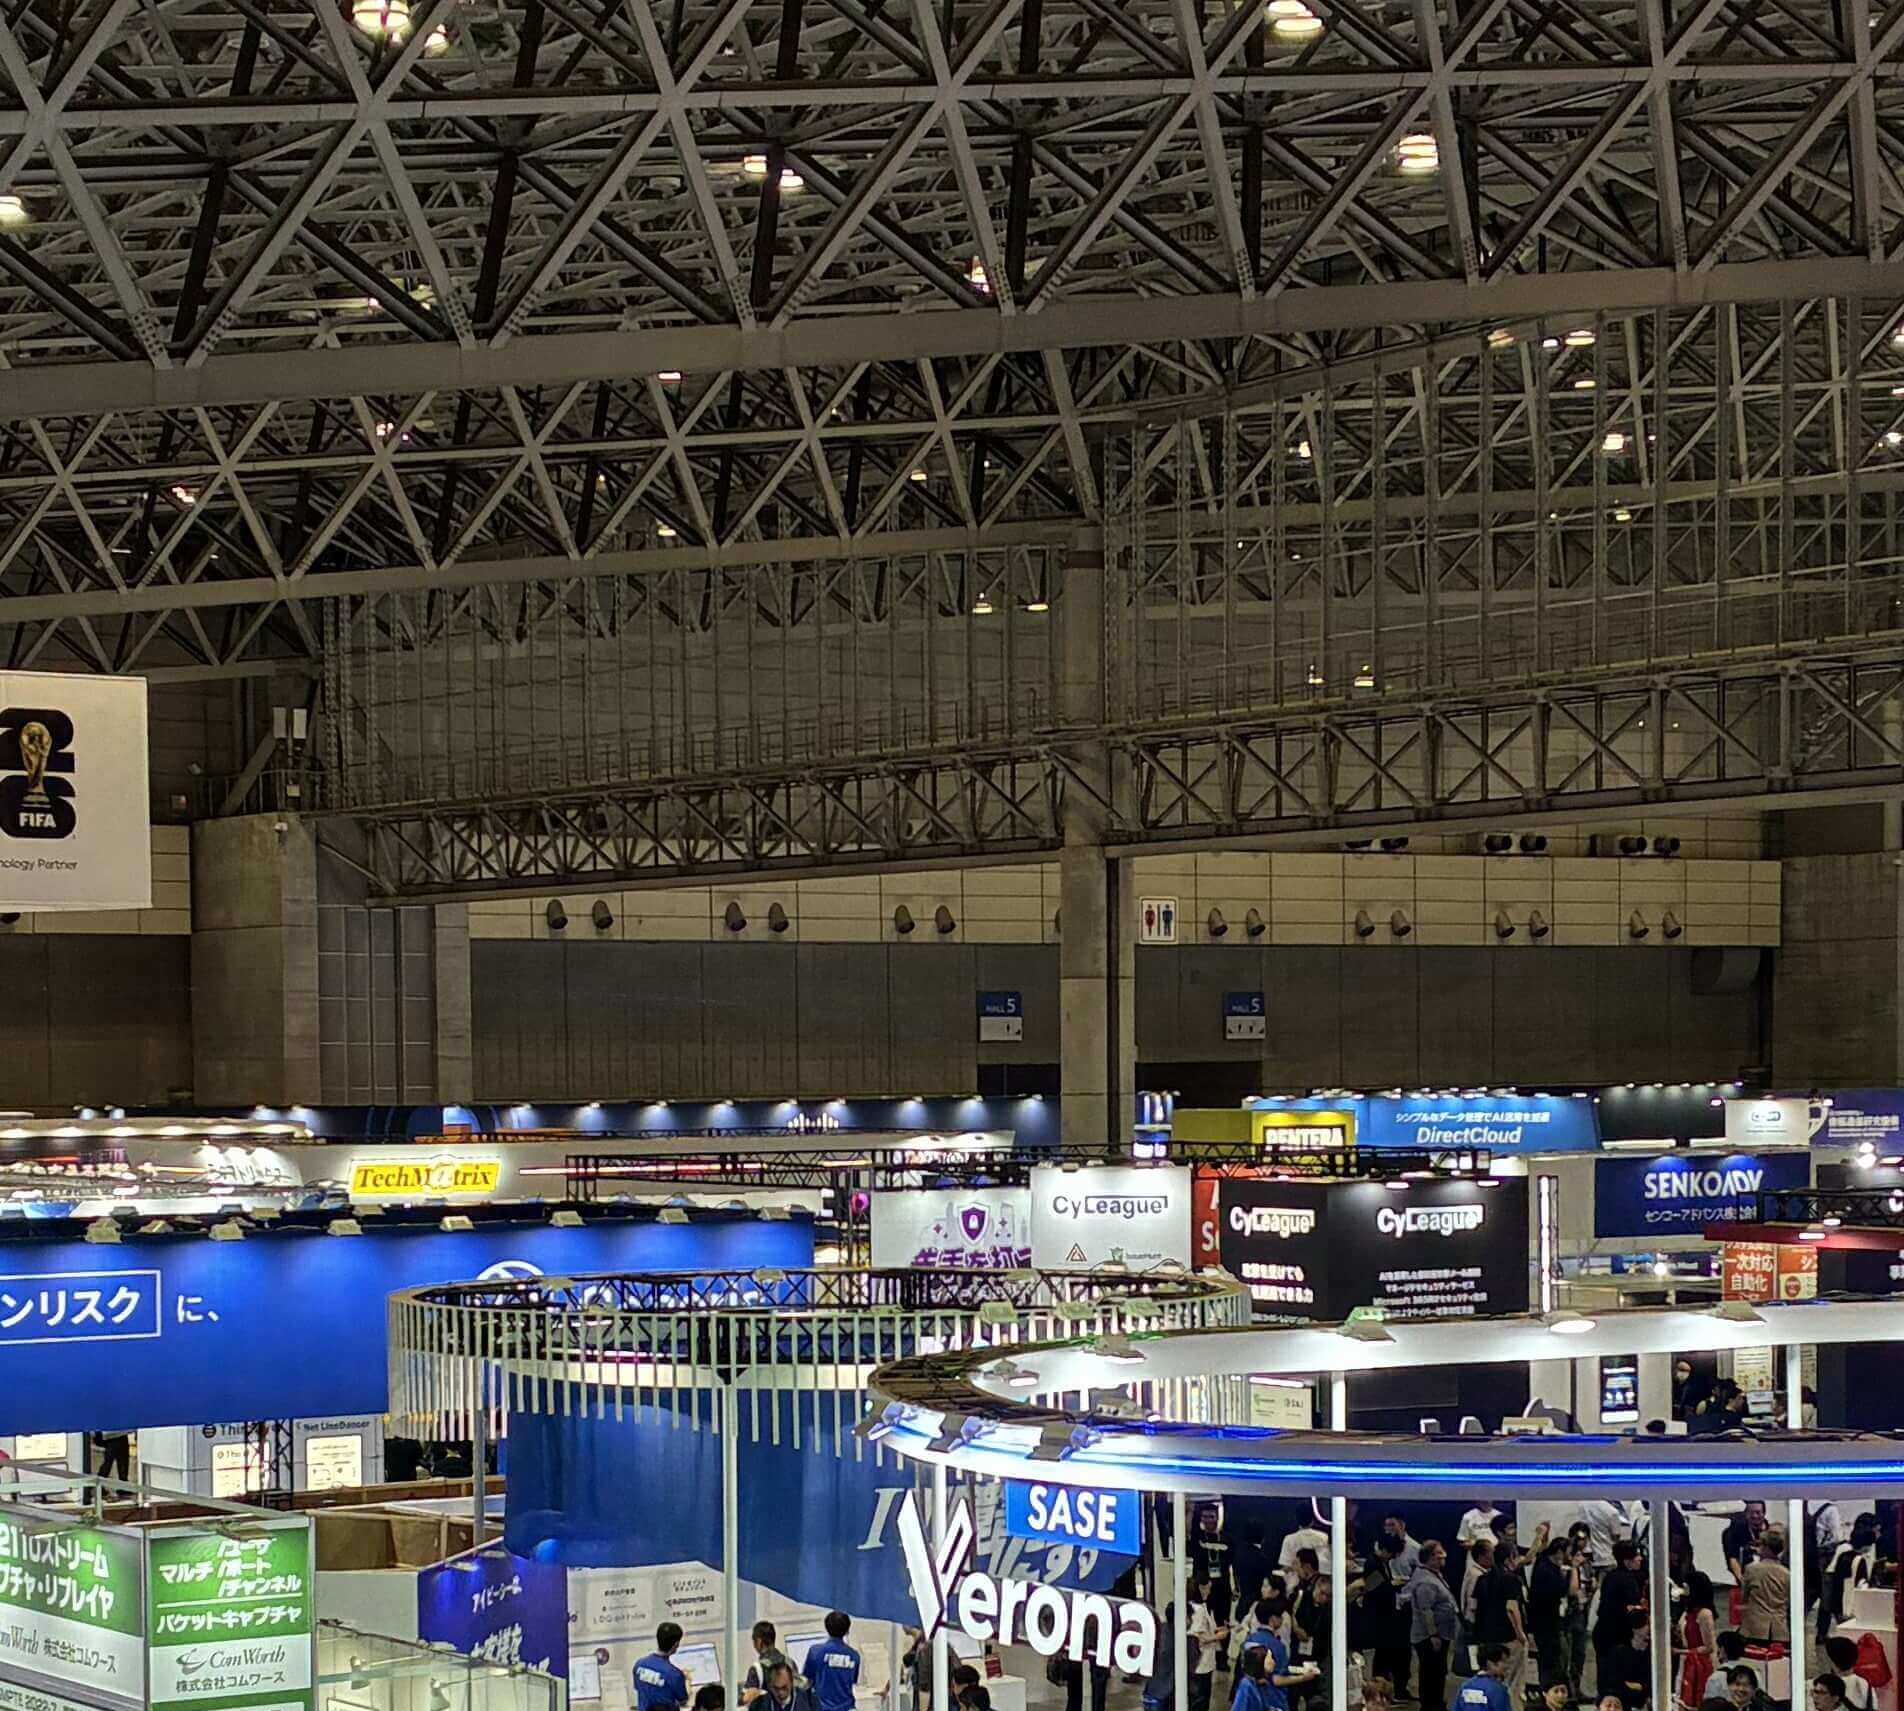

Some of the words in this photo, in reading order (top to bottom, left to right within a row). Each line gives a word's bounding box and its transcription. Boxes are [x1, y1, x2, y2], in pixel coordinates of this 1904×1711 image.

[18, 811, 57, 829] FIFA
[37, 858, 78, 871] Partner
[1006, 998, 1017, 1014] 5
[1249, 997, 1260, 1014] 5
[1415, 1126, 1522, 1144] DirectCloud
[1052, 1194, 1169, 1220] CyLeague
[1229, 1206, 1315, 1238] CyLeague
[1376, 1204, 1485, 1238] CyLeague
[1027, 1484, 1117, 1542] SASE
[158, 1561, 215, 1585] マルチ
[897, 1489, 1156, 1678] Verona
[156, 1604, 303, 1635] パケットキャプチャ
[175, 1670, 286, 1695] 株式会社コムワース
